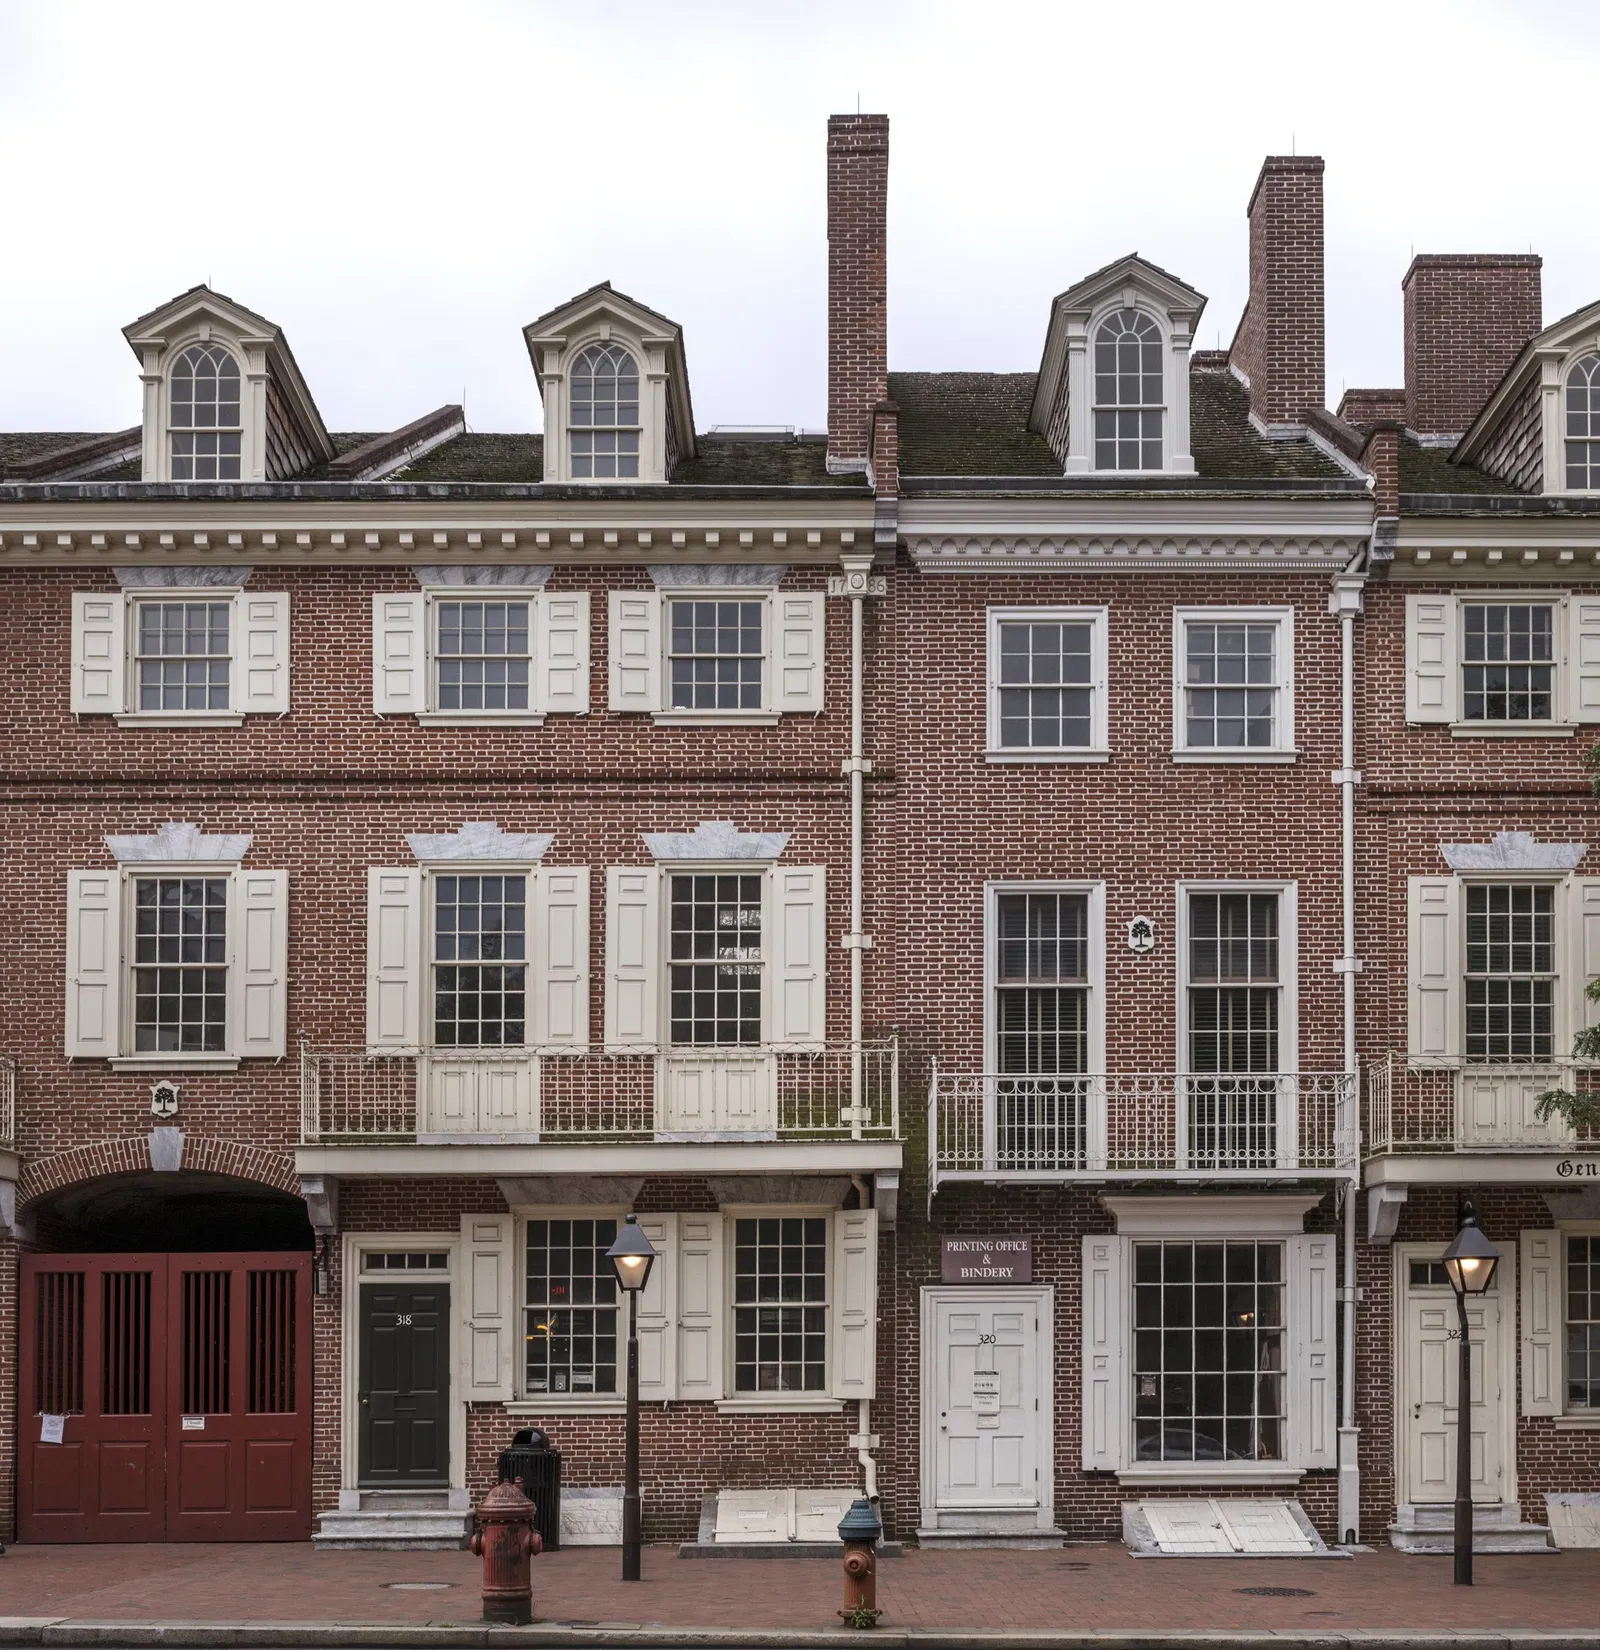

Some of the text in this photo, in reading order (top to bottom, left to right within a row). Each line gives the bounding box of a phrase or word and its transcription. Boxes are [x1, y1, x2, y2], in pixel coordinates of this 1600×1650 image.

[1556, 1160, 1600, 1177] Gen
[947, 1241, 1028, 1251] PRINTING OFFICE
[982, 1254, 991, 1264] &
[960, 1267, 1014, 1278] BINDERY
[395, 1314, 412, 1326] 318
[977, 1334, 997, 1345] 320
